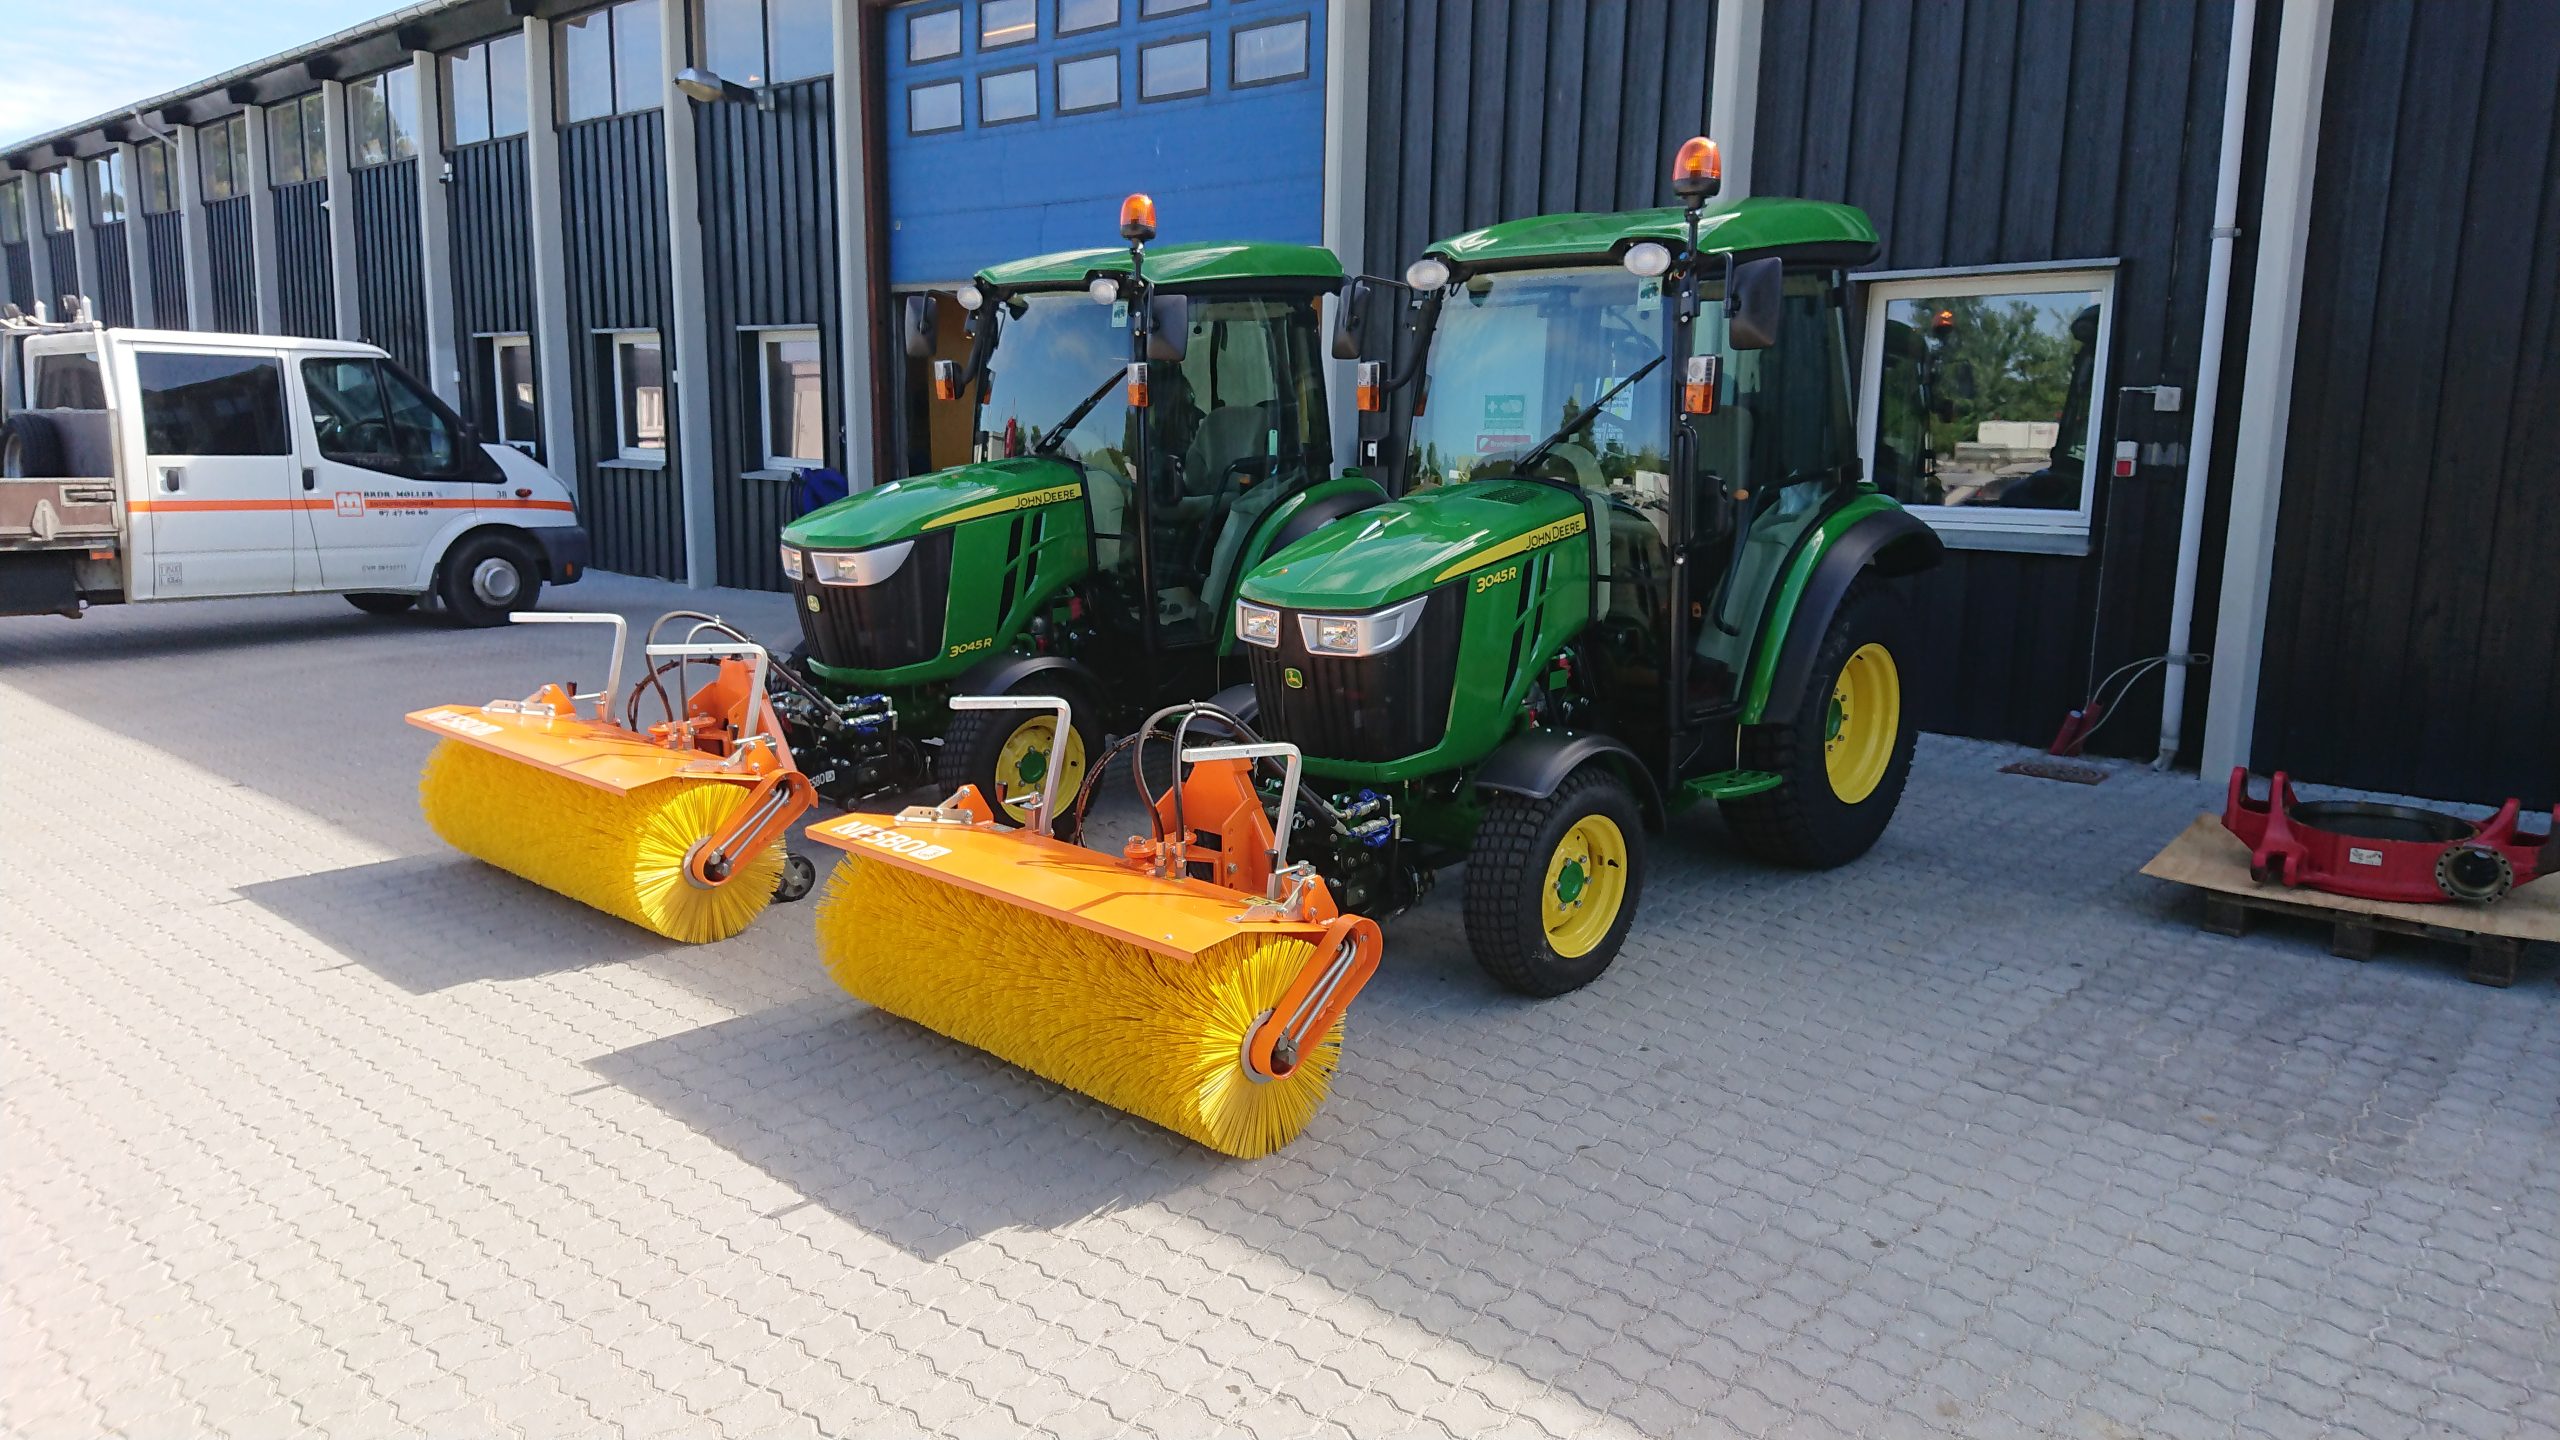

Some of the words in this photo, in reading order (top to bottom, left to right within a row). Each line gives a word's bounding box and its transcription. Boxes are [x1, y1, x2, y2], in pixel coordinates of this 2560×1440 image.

[1014, 494, 1043, 509] JOHN
[1044, 488, 1076, 503] DEERE
[1526, 530, 1551, 550] JOHN
[1552, 520, 1581, 540] DEERE
[1476, 566, 1517, 593] 3045R
[949, 637, 993, 658] 3045R
[831, 820, 928, 853] NESBO
